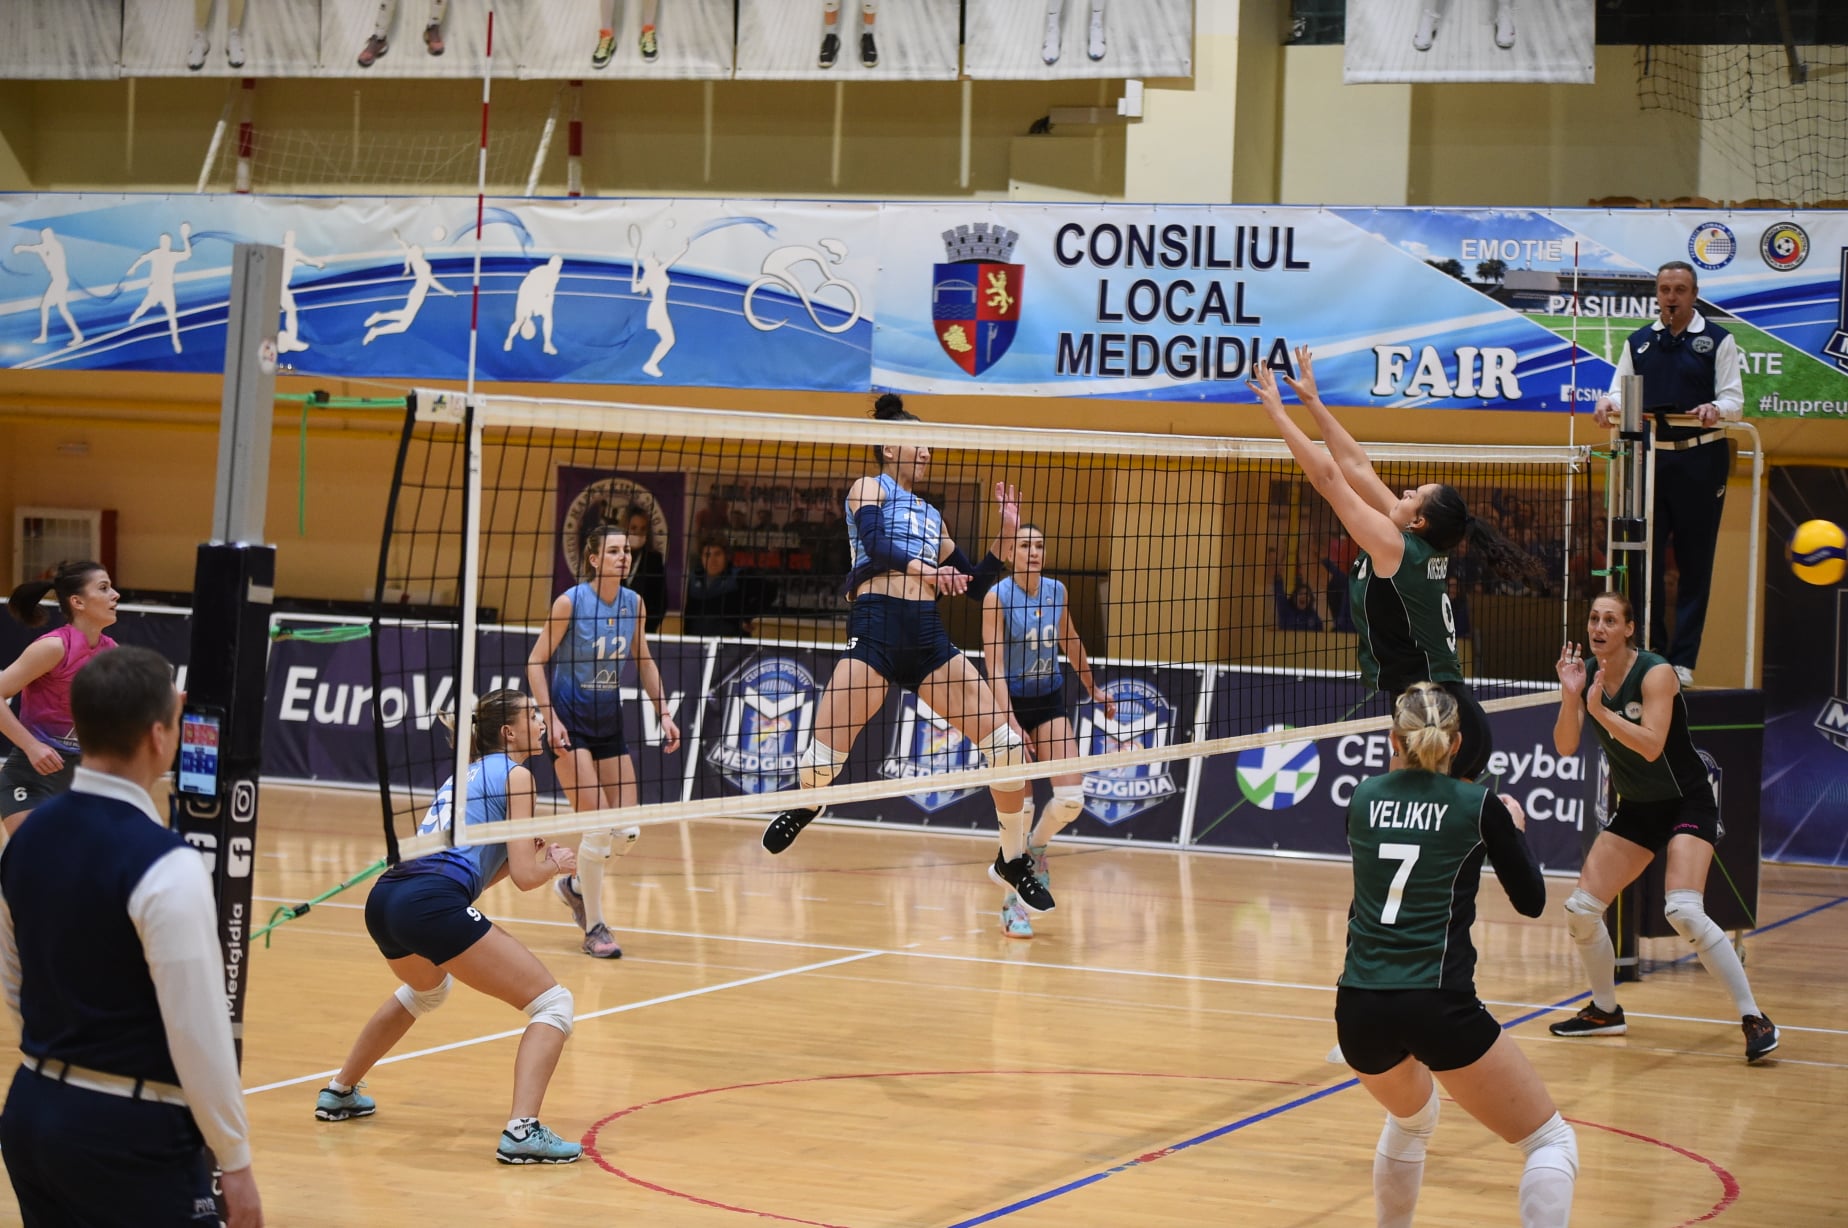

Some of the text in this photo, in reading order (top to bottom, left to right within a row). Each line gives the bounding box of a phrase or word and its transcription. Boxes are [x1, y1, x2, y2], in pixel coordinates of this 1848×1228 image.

[1054, 222, 1311, 271] CONSILIUL
[1097, 277, 1262, 326] LOCAL
[1055, 331, 1297, 382] MEDGIDIA
[1371, 344, 1522, 399] FAIR
[1738, 351, 1783, 375] ATE
[903, 511, 940, 545] 15
[1441, 592, 1456, 653] 9
[591, 636, 627, 660] 12
[13, 786, 28, 802] 6
[1082, 775, 1174, 798] EDGIDIA
[1368, 799, 1448, 832] VELIKIY
[1377, 842, 1421, 925] 7
[225, 903, 244, 1017] Medgidia
